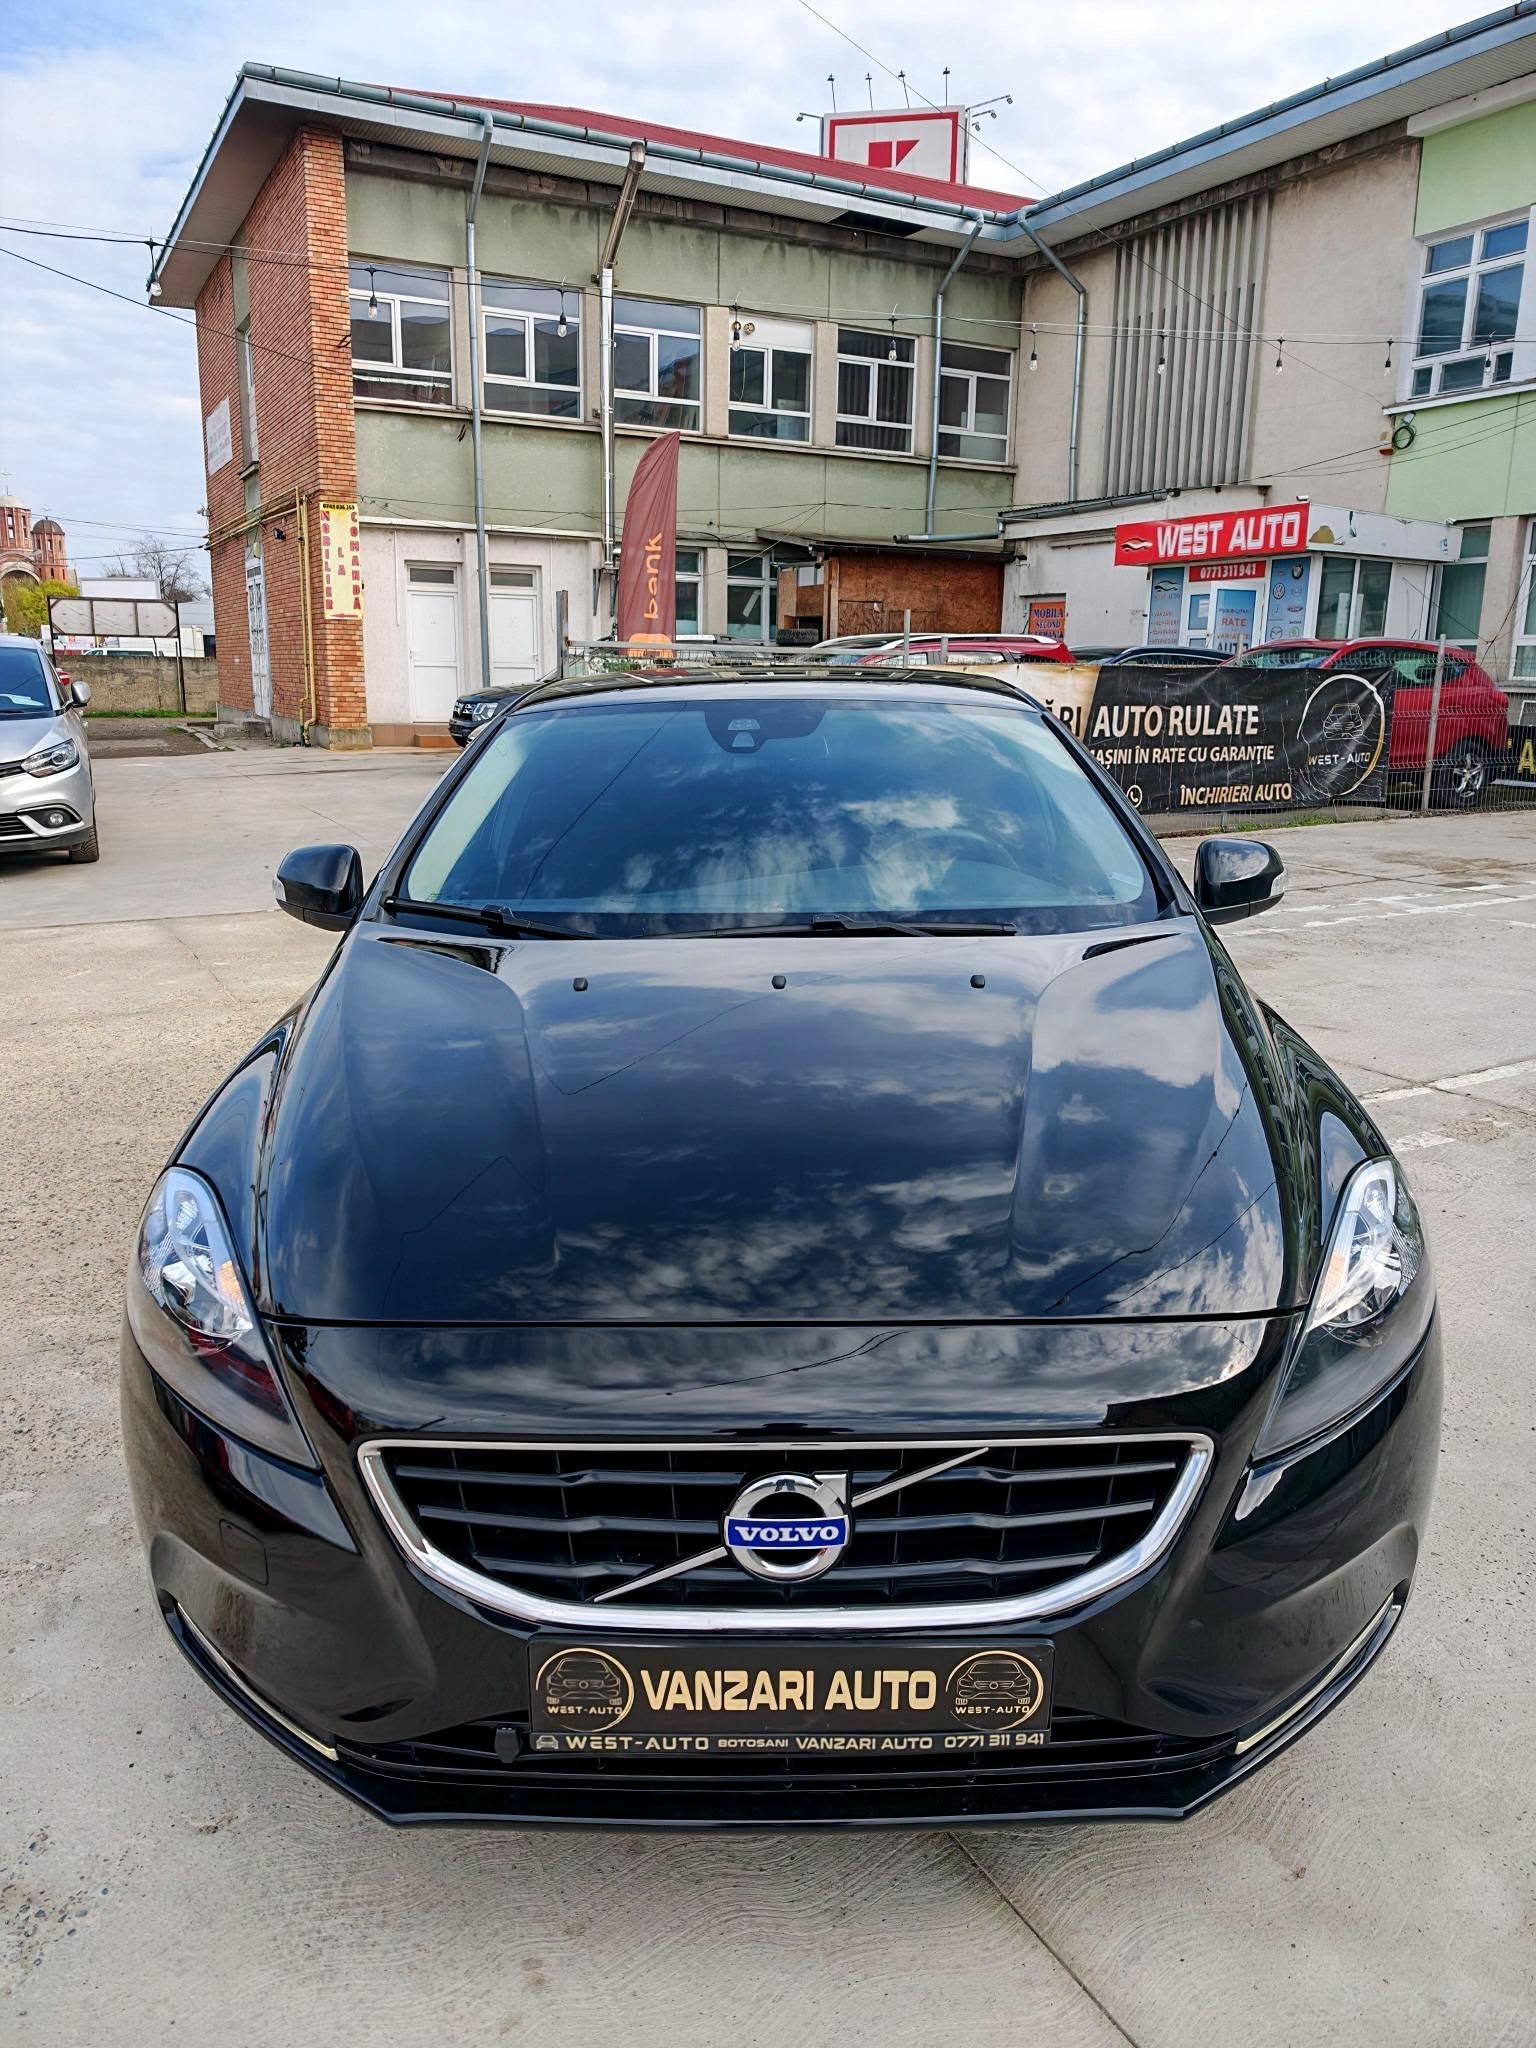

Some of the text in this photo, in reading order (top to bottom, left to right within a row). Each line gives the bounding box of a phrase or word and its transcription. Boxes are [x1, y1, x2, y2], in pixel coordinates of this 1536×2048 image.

[1157, 512, 1301, 558] WEST AUTO
[338, 547, 346, 576] LA
[643, 532, 662, 619] bank
[1221, 618, 1247, 627] RATE
[1092, 705, 1162, 738] AUTO
[1168, 704, 1259, 736] RULATE
[1134, 745, 1149, 764] ÎN
[1152, 748, 1186, 763] RATE
[1188, 747, 1207, 762] CU
[1307, 752, 1371, 766] WEST-AUTO
[1180, 783, 1292, 805] ÎNCHIRIERI AUTO
[734, 1526, 839, 1542] VOLVO
[640, 1670, 937, 1711] VANZARI AUTO
[547, 1705, 623, 1715] WEST-AUTO
[955, 1705, 1031, 1715] WEST-AUTO
[565, 1733, 1044, 1751] WEST-AUTO BOTOSANI VANZARI AUTO 0771 311 941
